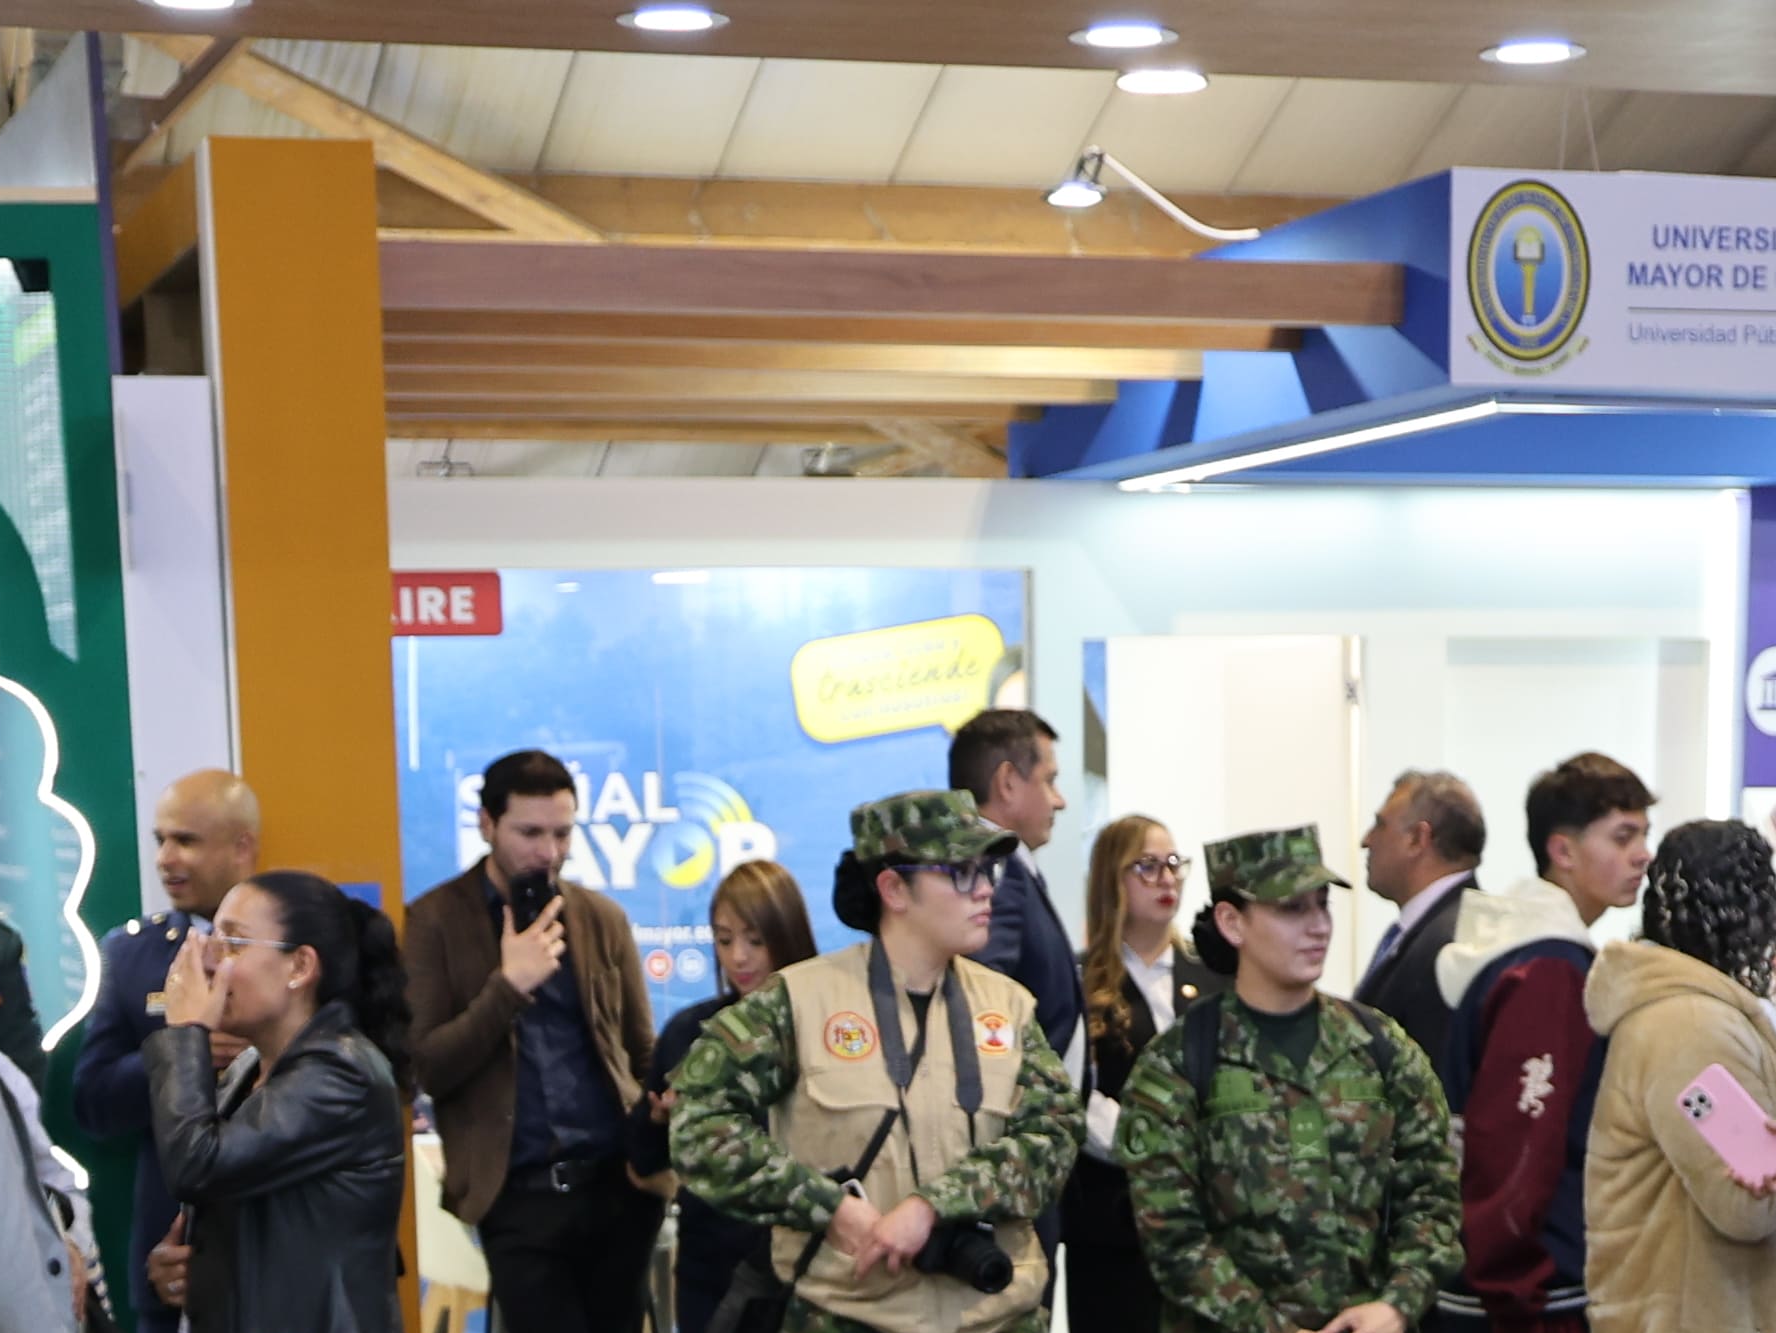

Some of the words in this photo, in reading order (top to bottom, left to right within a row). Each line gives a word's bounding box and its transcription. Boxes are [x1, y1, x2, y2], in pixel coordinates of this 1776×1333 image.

[1628, 262, 1723, 288] MAYOR
[1733, 265, 1767, 289] DE
[1629, 322, 1736, 343] Universidad
[391, 586, 475, 624] IRE
